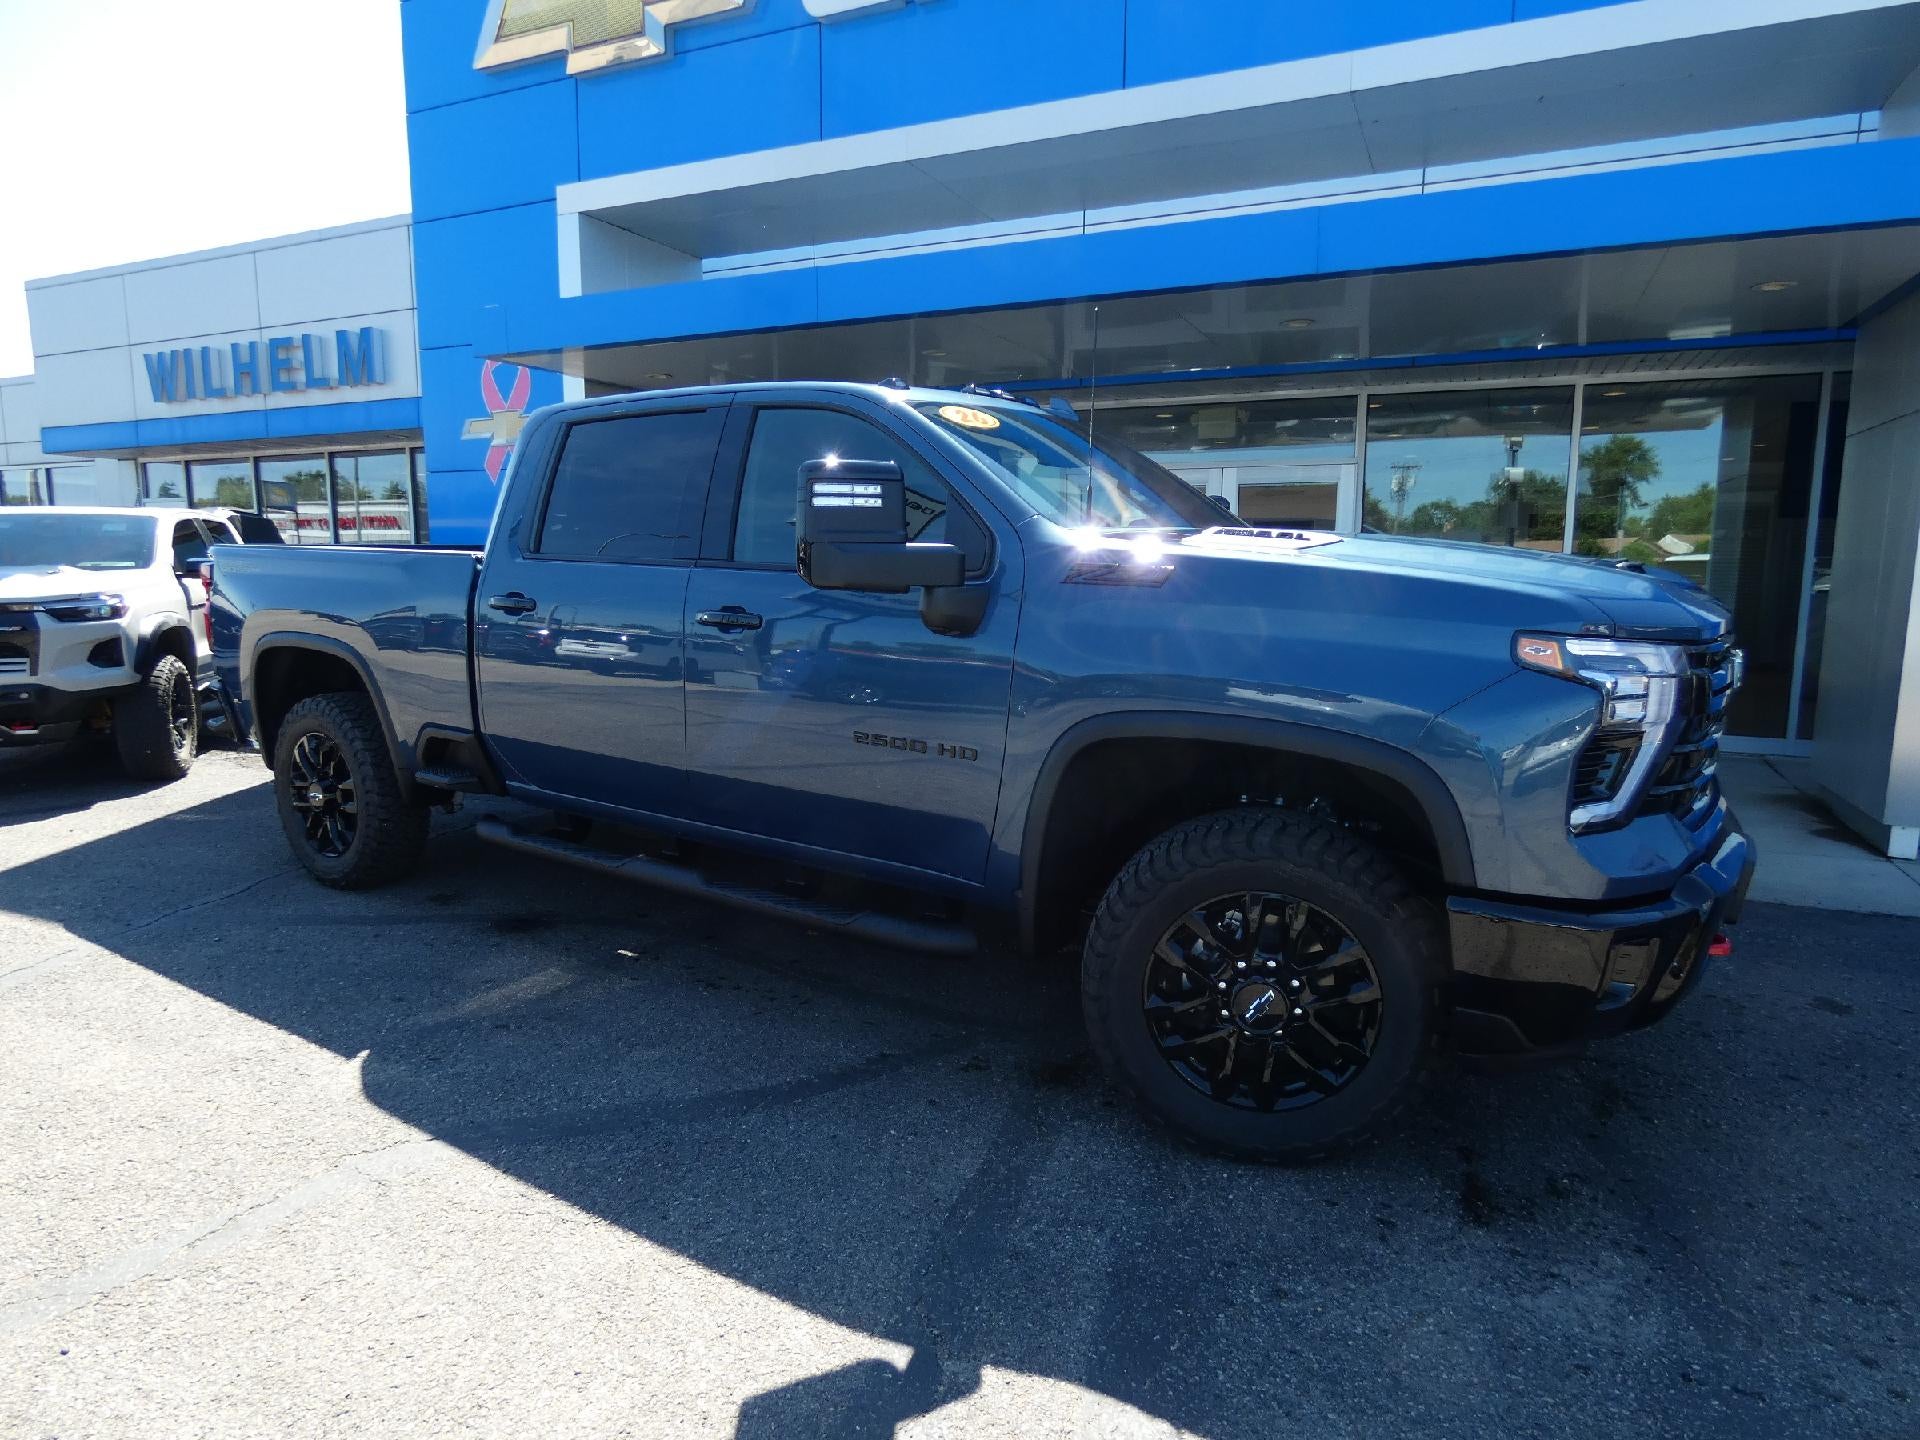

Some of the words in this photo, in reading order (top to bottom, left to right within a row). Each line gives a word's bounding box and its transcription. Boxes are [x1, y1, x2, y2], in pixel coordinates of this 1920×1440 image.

[143, 326, 385, 402] WILHELM
[853, 730, 927, 754] 2500
[937, 742, 978, 761] HD
